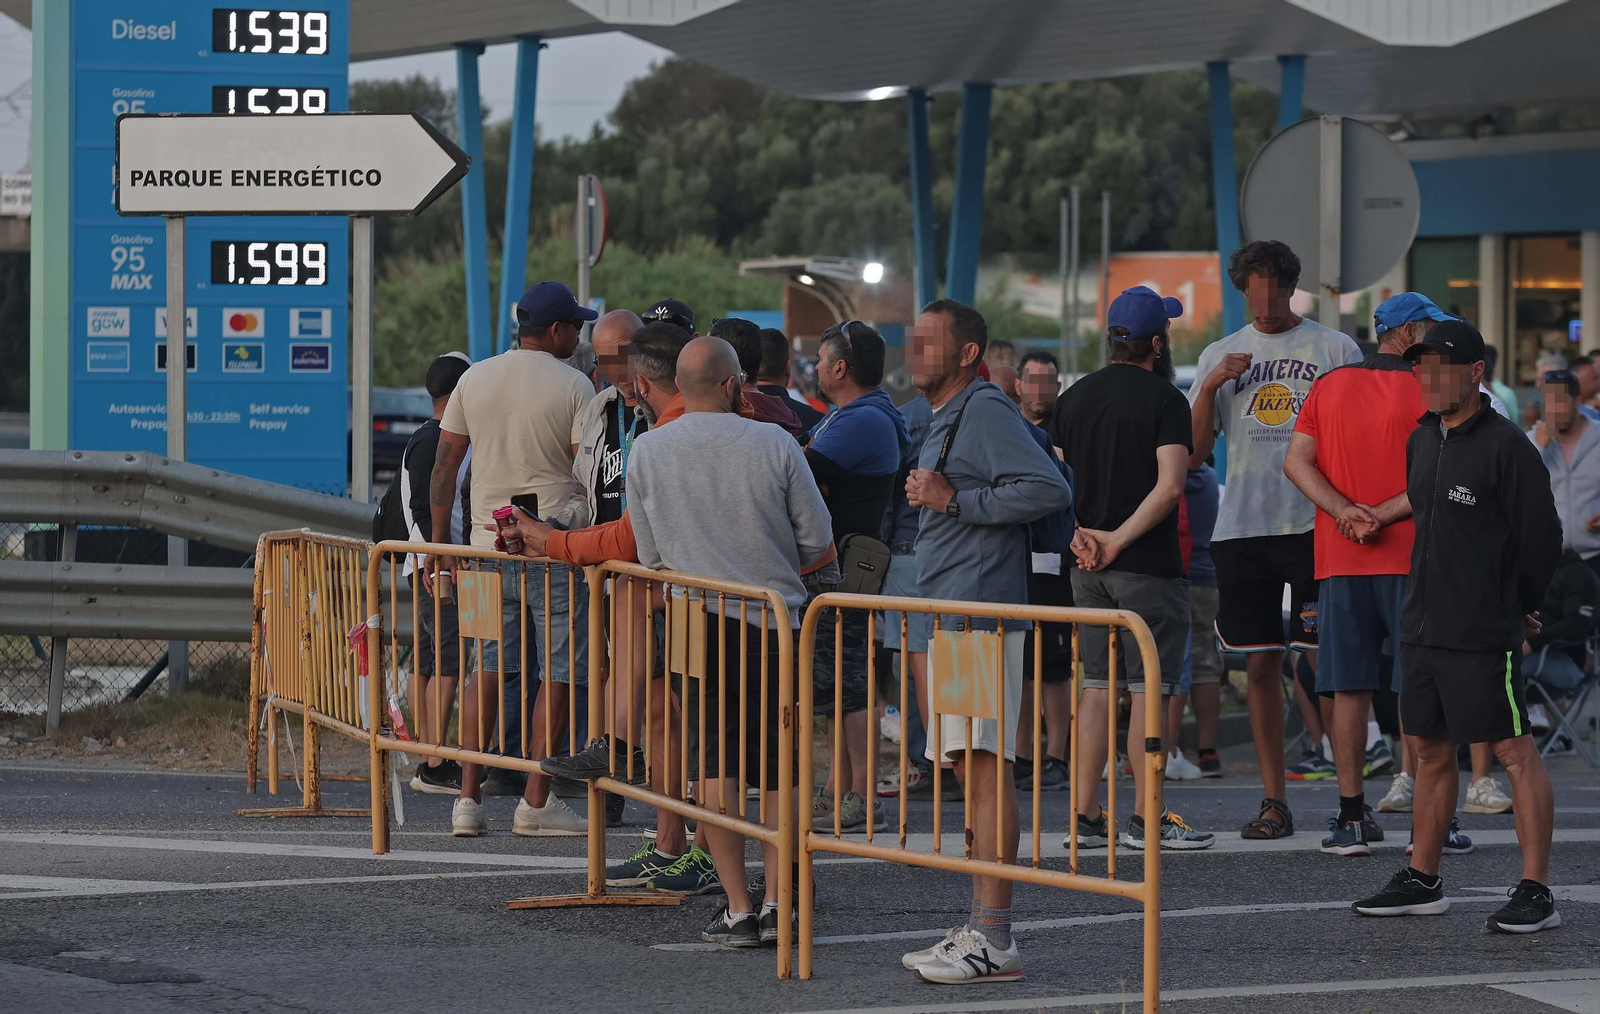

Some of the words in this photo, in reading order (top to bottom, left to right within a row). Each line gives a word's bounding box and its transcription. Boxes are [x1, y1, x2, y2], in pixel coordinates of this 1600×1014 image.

[112, 19, 177, 40] Diesel
[228, 11, 328, 55] 1.539
[112, 87, 155, 99] Gasolina
[130, 169, 223, 188] PARQUE
[230, 165, 382, 187] ENERGÉTICO
[111, 234, 154, 245] Gasolina
[111, 247, 146, 272] 95
[228, 242, 327, 286] 1.599
[111, 274, 153, 290] MAX
[1234, 359, 1319, 396] LAKERS
[249, 403, 270, 415] Self
[272, 404, 311, 415] service
[1243, 393, 1304, 416] LAKERS
[250, 419, 288, 432] Prepay
[1448, 489, 1477, 503] ZAHARA
